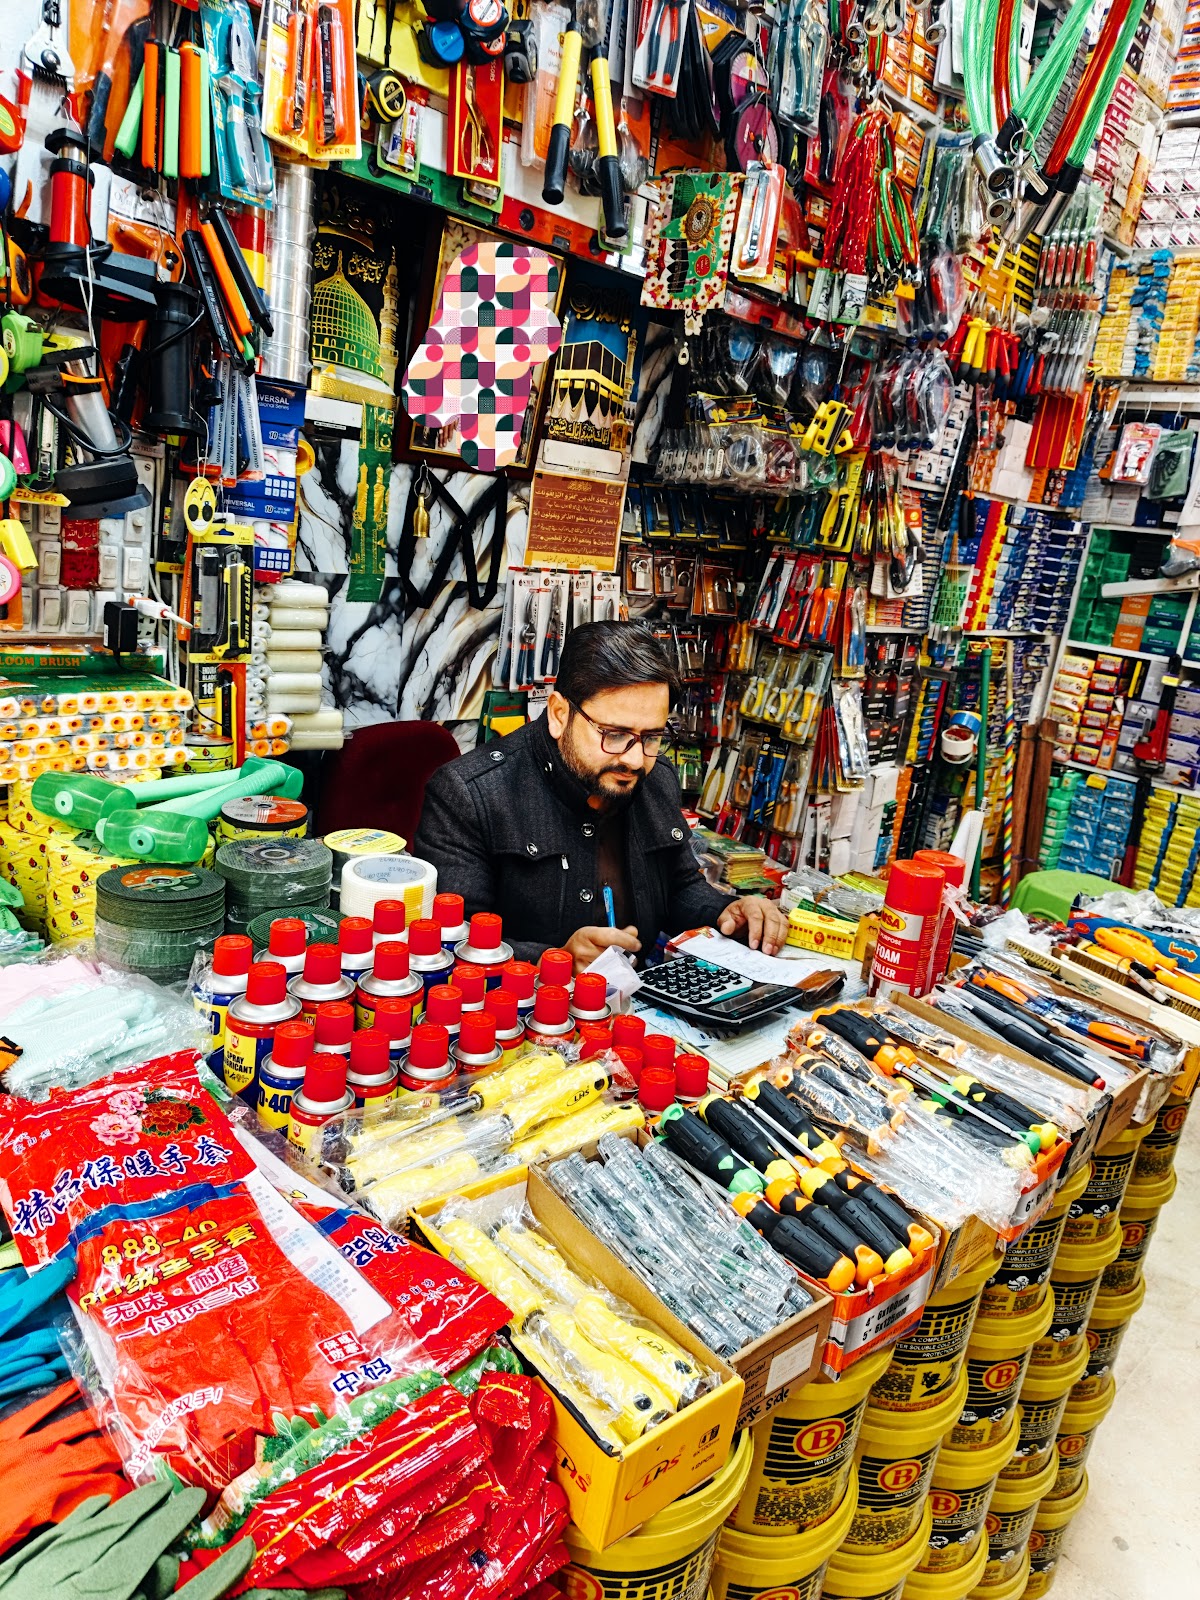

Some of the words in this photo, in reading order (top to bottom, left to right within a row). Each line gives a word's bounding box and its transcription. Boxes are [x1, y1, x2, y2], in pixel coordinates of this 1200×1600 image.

[315, 146, 351, 155] CUTTER
[257, 393, 290, 406] IVERSAL
[16, 489, 58, 502] CUTTER
[40, 656, 80, 667] BRUSH
[202, 682, 213, 695] 18
[875, 943, 901, 964] FOAM
[226, 1050, 244, 1064] SPRAY
[259, 1087, 292, 1114] D-40
[12, 1135, 233, 1236] 精品保暖手套
[116, 1274, 260, 1342] 一付顶三付
[877, 1294, 910, 1321] 6x100mm
[874, 1307, 907, 1334] 6x125mm
[909, 1341, 936, 1351] SOLUBLE
[918, 1333, 951, 1344] COMPLETE
[330, 1357, 392, 1395] 中码
[744, 1362, 766, 1380] Model
[744, 1380, 759, 1395] pec
[736, 1403, 762, 1429] ingle
[765, 1386, 790, 1411] Side
[740, 1391, 763, 1408] mount
